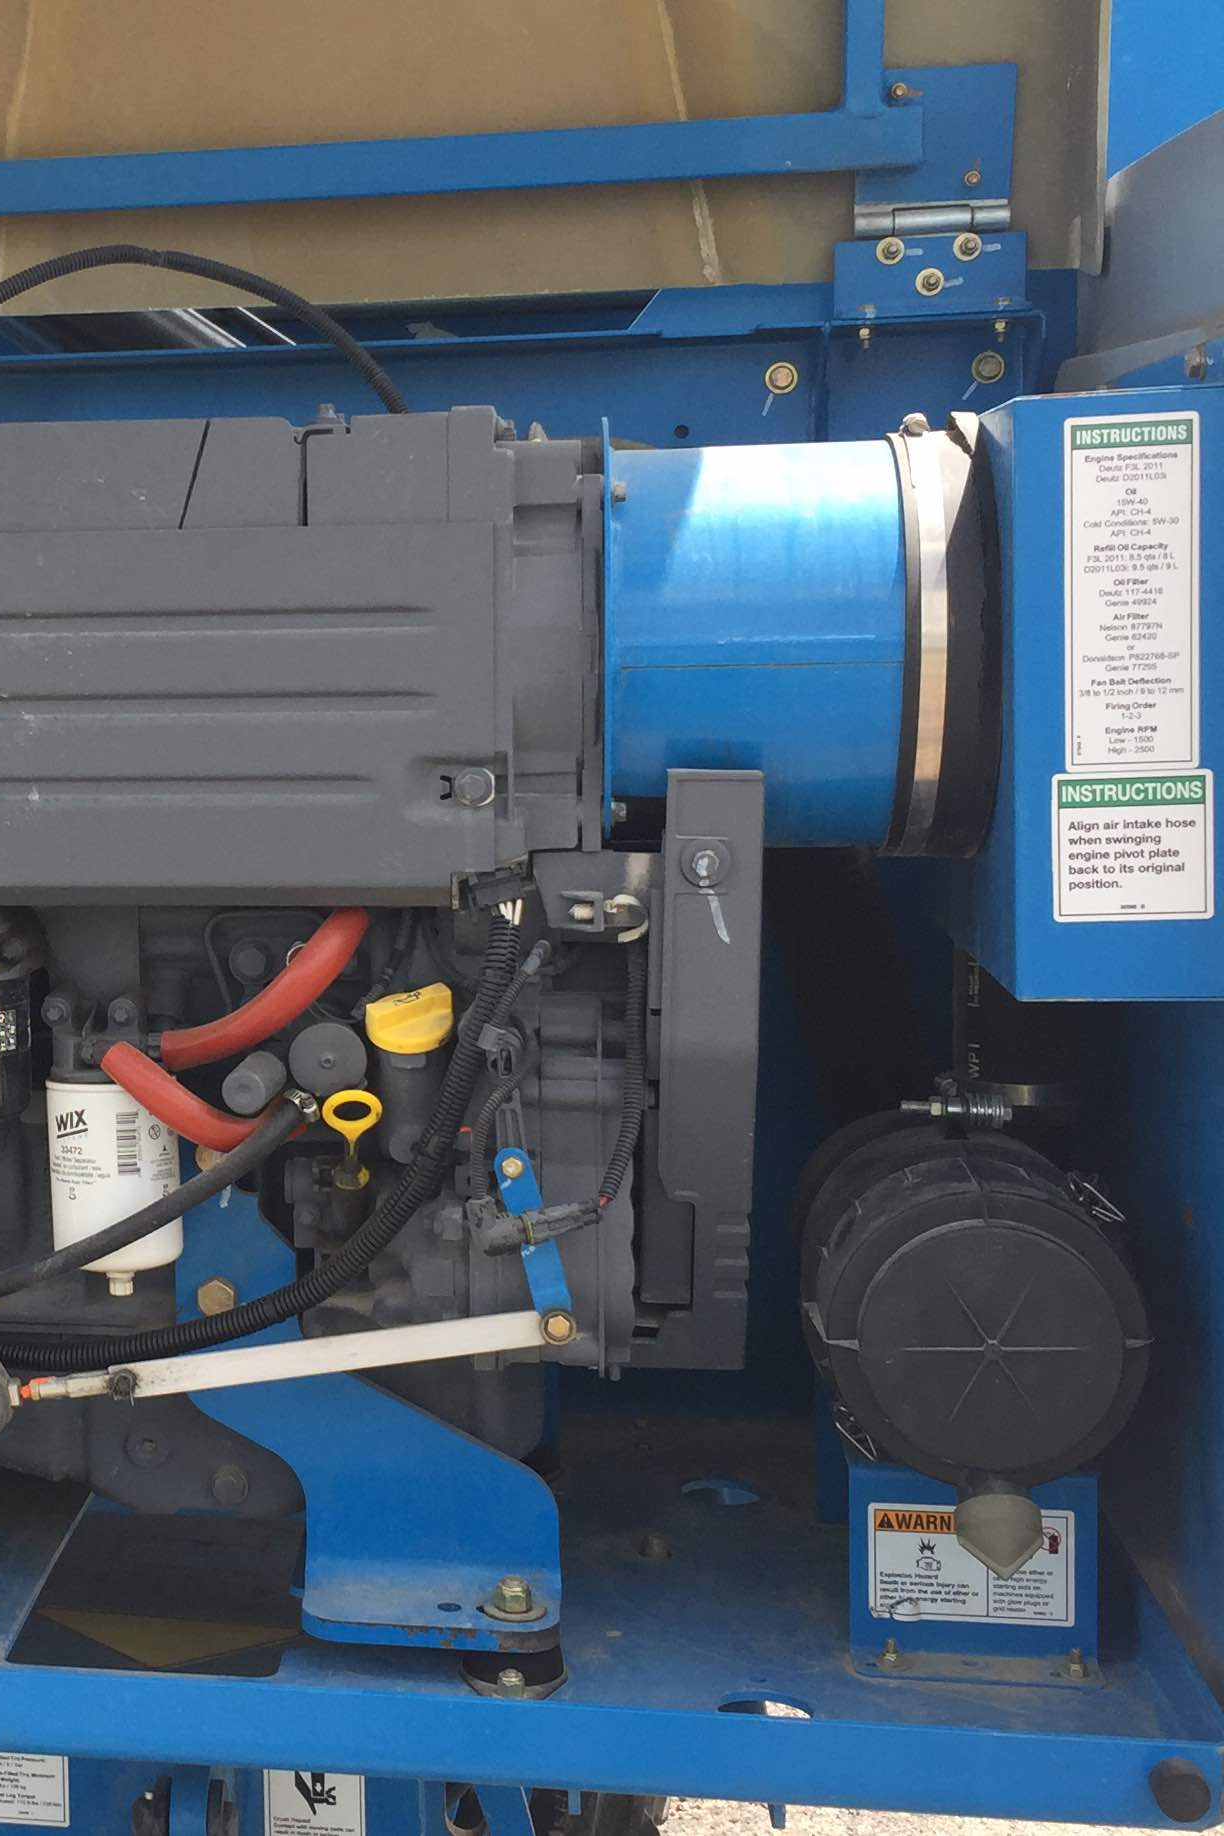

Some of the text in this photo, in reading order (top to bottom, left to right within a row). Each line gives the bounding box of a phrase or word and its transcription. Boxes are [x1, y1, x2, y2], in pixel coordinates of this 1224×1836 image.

[1076, 424, 1187, 445] INSTRUCTIONS
[1084, 452, 1178, 463] Engine Specifications
[1099, 465, 1122, 473] Deutz
[1143, 462, 1163, 470] 2011
[1096, 475, 1120, 483] Deutz
[1130, 508, 1151, 516] CH-4
[1083, 520, 1102, 528] Cold
[1094, 542, 1168, 552] Refill Oil Capacity
[1099, 589, 1122, 597] Deutz
[1105, 599, 1129, 607] Genie
[1099, 624, 1127, 632] Nelson
[1105, 634, 1129, 642] Genie
[1082, 654, 1125, 663] Donaldson
[1105, 664, 1129, 672] Genie
[1091, 677, 1172, 687] Fan Belt Deflection
[1117, 687, 1133, 695] inch
[1105, 703, 1130, 711] Firing
[1121, 712, 1142, 720] 1-2-3
[1105, 725, 1157, 735] Engine RPM
[1108, 747, 1127, 756] High
[1062, 781, 1203, 802] INSTRUCTIONS
[1068, 818, 1196, 833] Align air intake hose
[1068, 833, 1162, 846] when swinging
[1068, 848, 1180, 862] engine pivot plate
[1068, 862, 1185, 875] back to its original
[1068, 878, 1123, 891] position.
[56, 1109, 87, 1133] WIX
[60, 1145, 82, 1155] 33472
[895, 1513, 951, 1531] WARN
[880, 1571, 913, 1579] Explosion
[936, 1581, 955, 1589] injury
